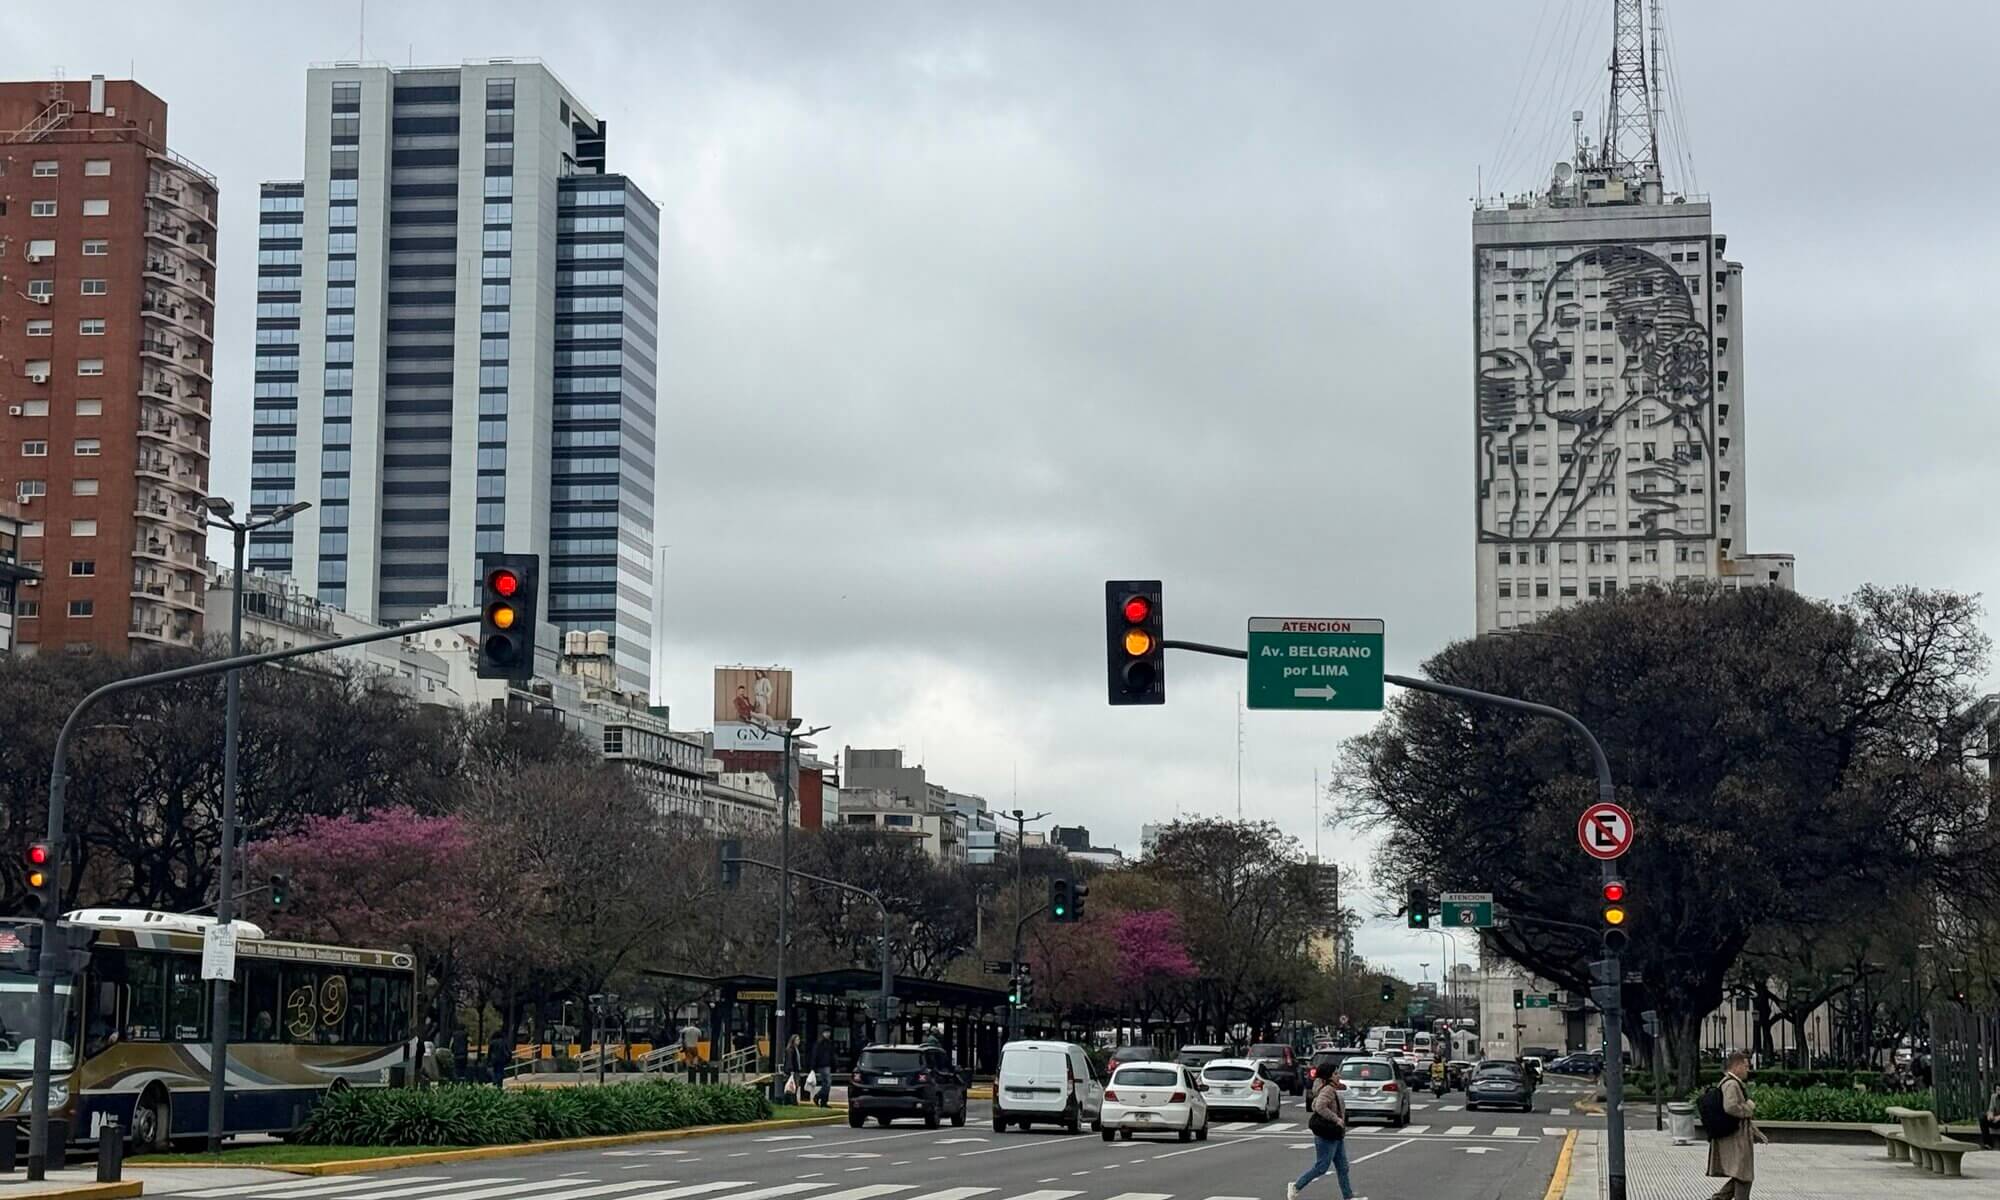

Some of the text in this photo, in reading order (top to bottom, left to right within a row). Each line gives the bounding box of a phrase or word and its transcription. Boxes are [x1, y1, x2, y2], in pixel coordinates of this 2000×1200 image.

[1282, 621, 1351, 632] ATENCIÓN
[1260, 645, 1372, 658] Av. BELGRANO
[1283, 664, 1349, 678] por LIMA
[287, 974, 349, 1038] 39
